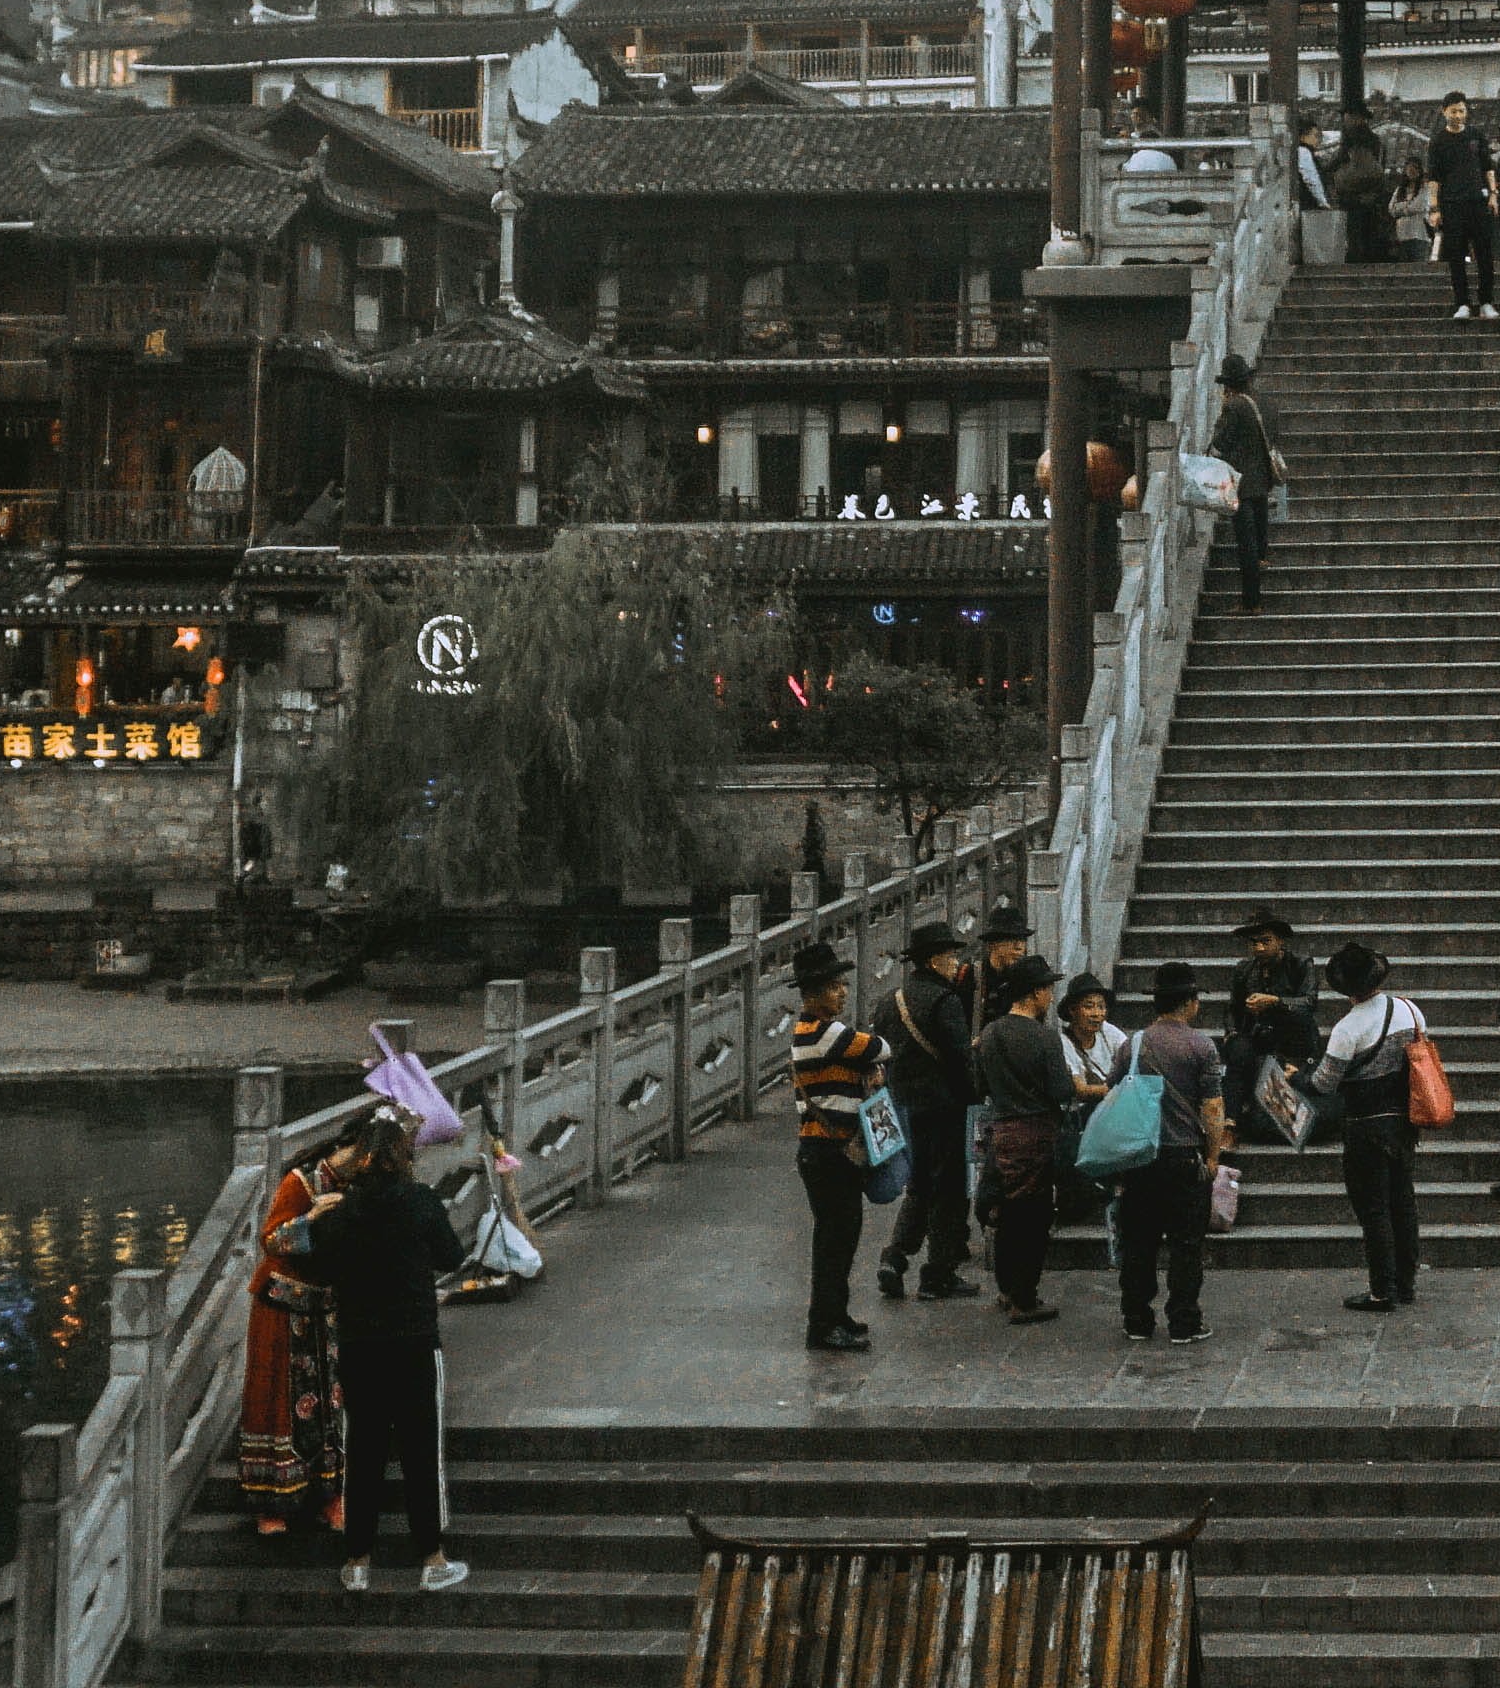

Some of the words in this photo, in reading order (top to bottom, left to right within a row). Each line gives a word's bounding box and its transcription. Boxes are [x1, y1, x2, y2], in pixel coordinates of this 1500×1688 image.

[0, 721, 201, 760] 苗家土菜馆
